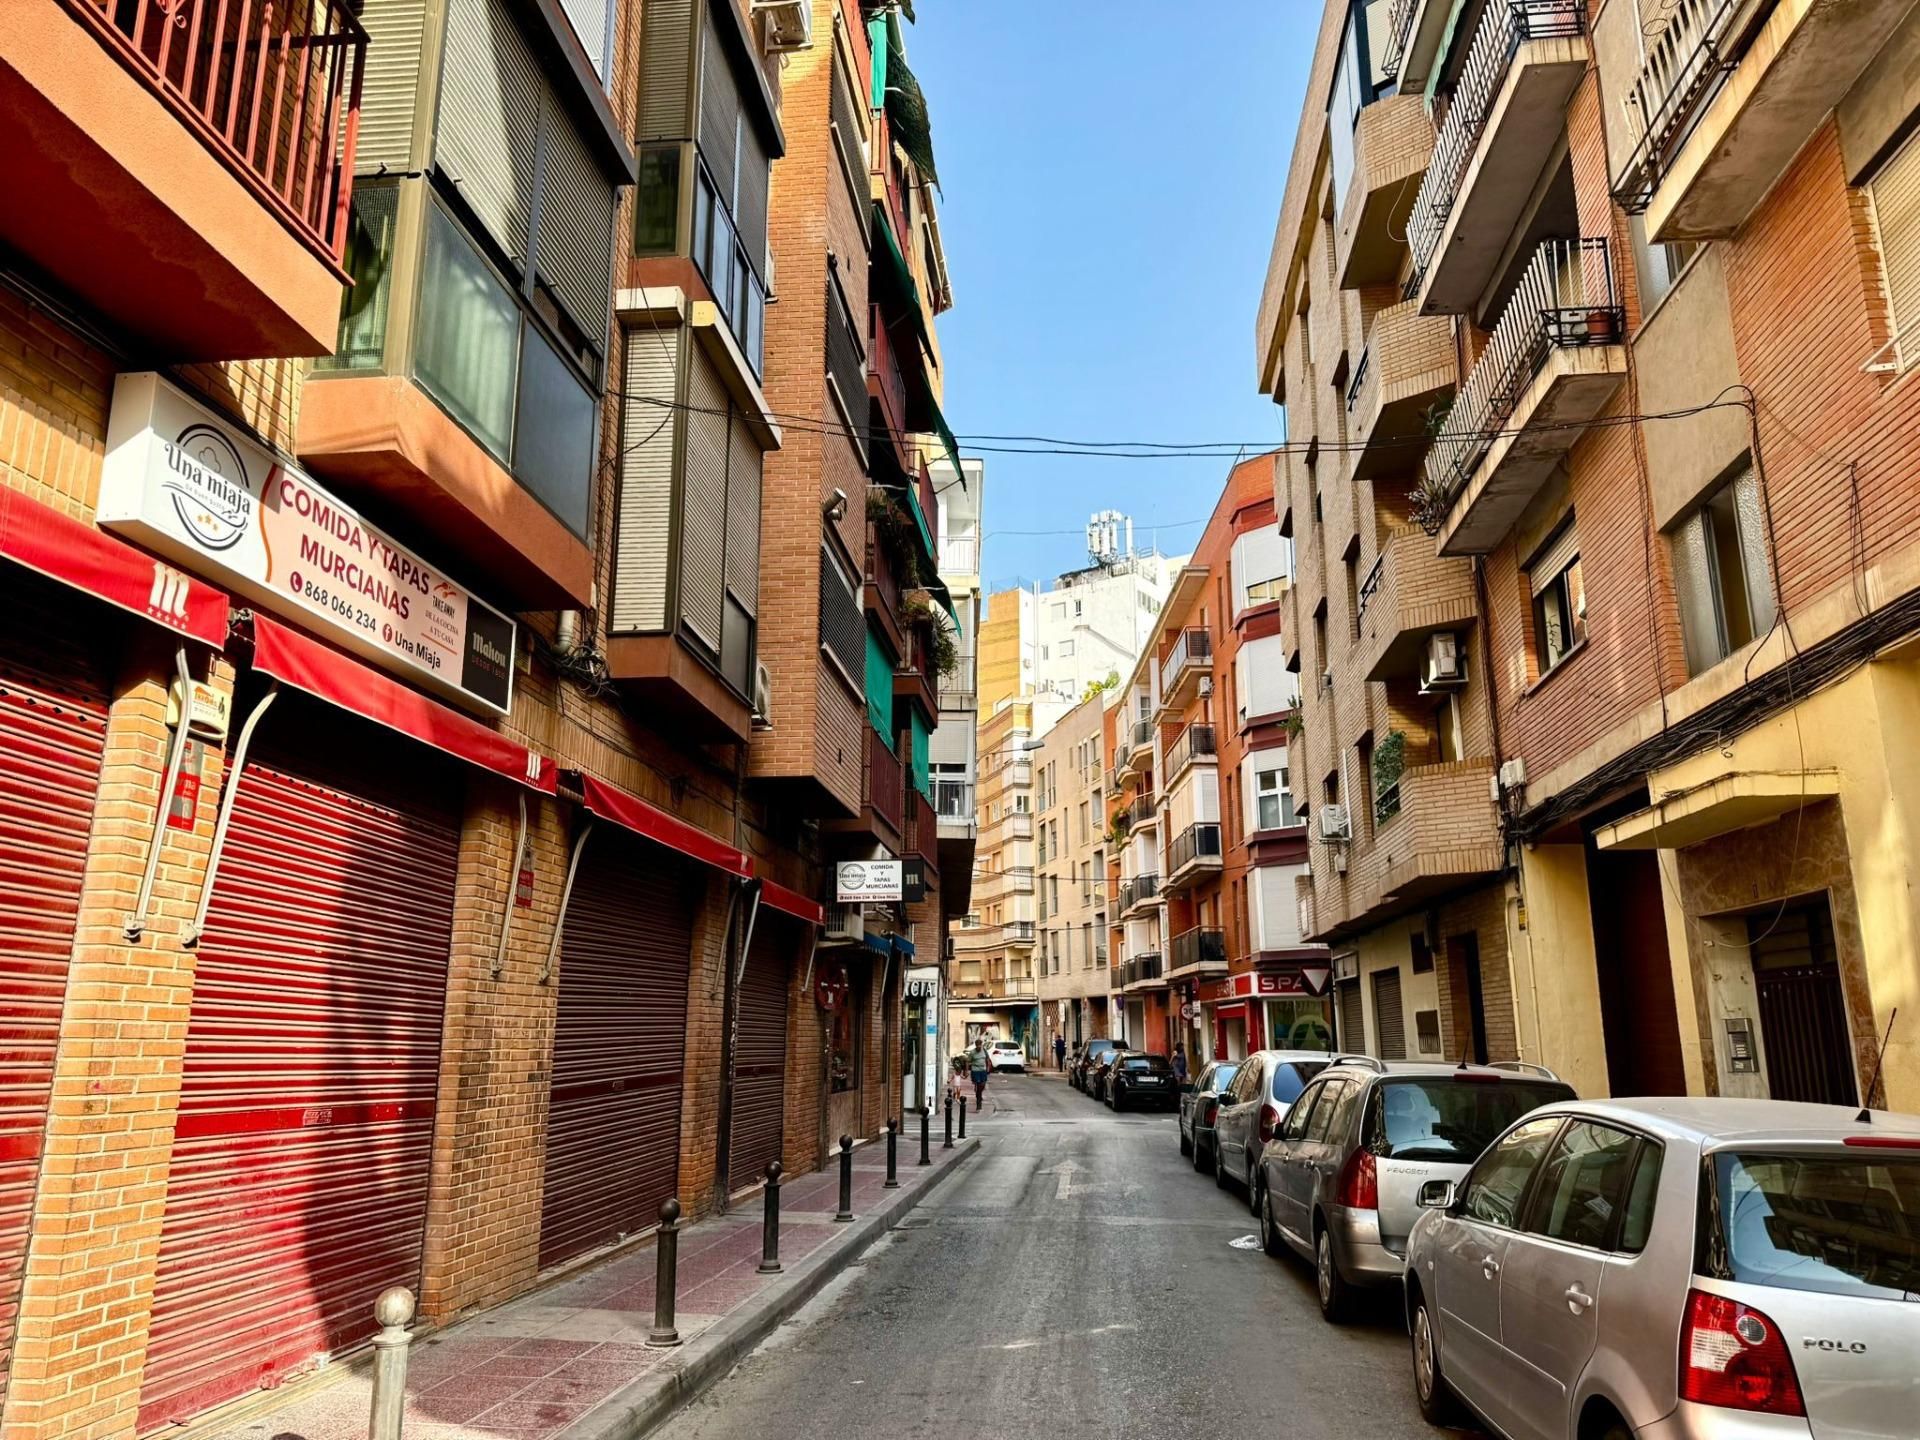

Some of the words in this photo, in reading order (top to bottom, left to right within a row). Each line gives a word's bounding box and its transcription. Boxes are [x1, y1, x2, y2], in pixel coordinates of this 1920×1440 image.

[164, 443, 202, 486] Una
[207, 475, 251, 516] miaja
[280, 479, 363, 553] COMIDA
[367, 534, 379, 560] Y
[382, 543, 430, 596] TAPAS
[300, 533, 411, 621] MURCIANAS
[304, 580, 329, 606] 868
[331, 595, 353, 620] 066
[355, 609, 377, 633] 234
[425, 609, 432, 620] DE
[432, 613, 439, 625] LA
[440, 618, 459, 636] COCINA
[395, 630, 414, 654] Una
[416, 642, 441, 670] Miaja
[472, 631, 506, 668] Mahou
[1261, 976, 1303, 991] SPA
[1183, 1007, 1194, 1015] 30
[1386, 1167, 1429, 1176] PEUGEOT
[1802, 1336, 1867, 1354] POLO
